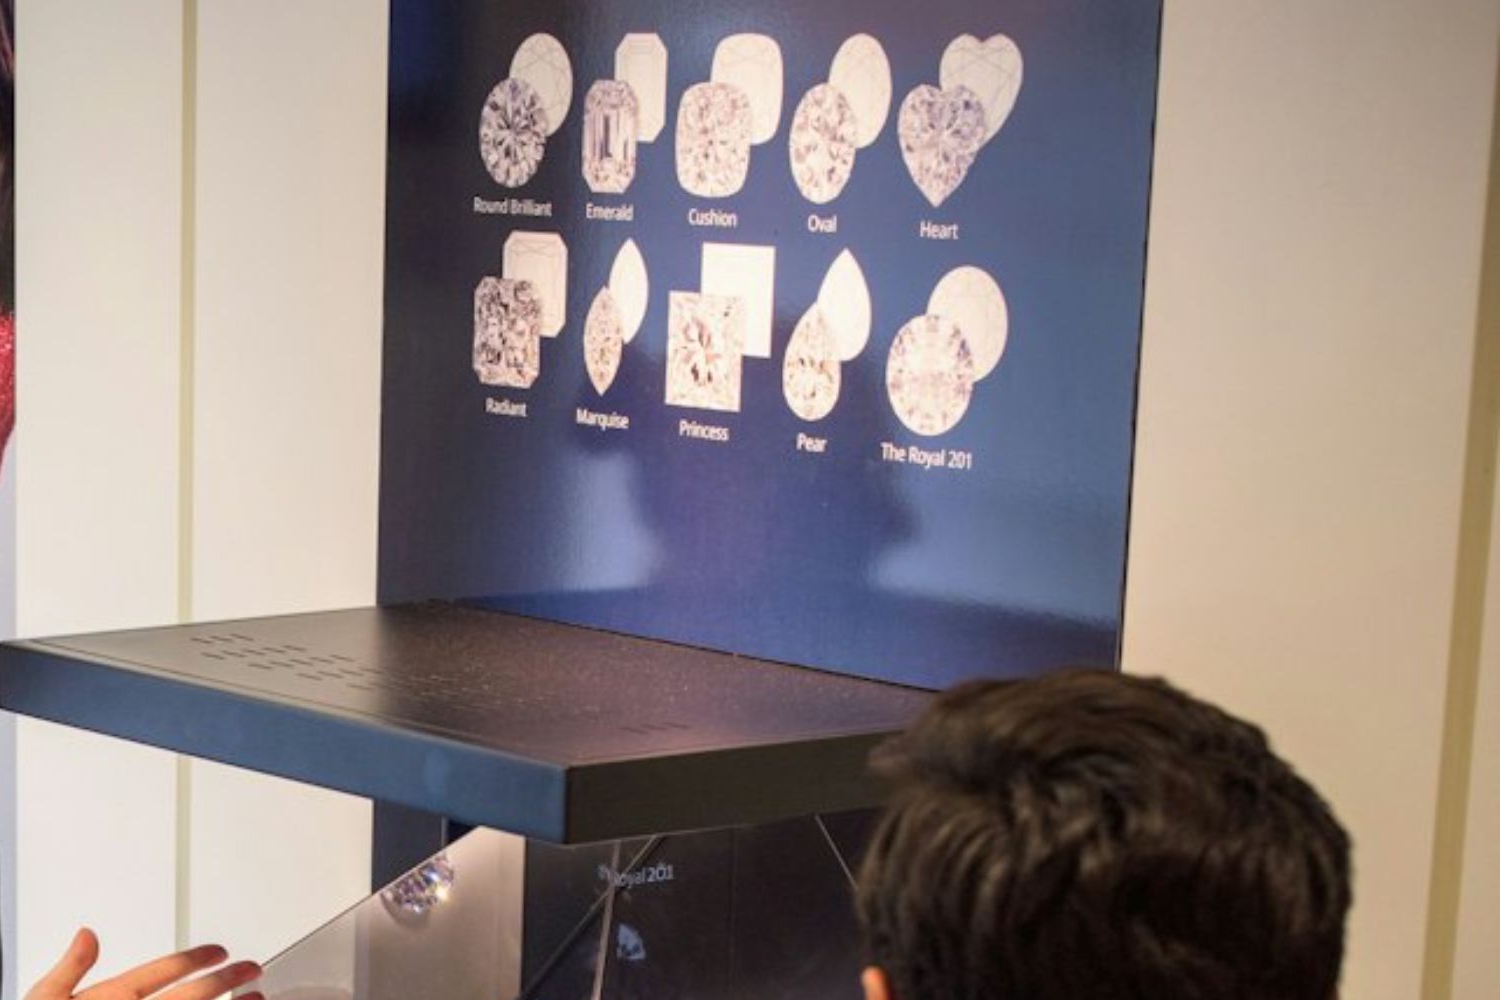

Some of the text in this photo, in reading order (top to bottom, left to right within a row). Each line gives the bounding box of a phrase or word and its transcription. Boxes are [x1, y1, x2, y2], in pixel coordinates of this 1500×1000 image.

[473, 196, 552, 217] Round Brilliant
[585, 202, 634, 222] Emerald
[688, 207, 738, 229] Cushion
[807, 214, 838, 233] Oval
[919, 219, 959, 240] Heart
[485, 397, 527, 418] Radiant
[576, 407, 630, 431] Marquise
[678, 418, 730, 442] Princess
[795, 432, 828, 453] Pear
[880, 441, 973, 471] The Royal 201
[646, 864, 674, 883] 201
